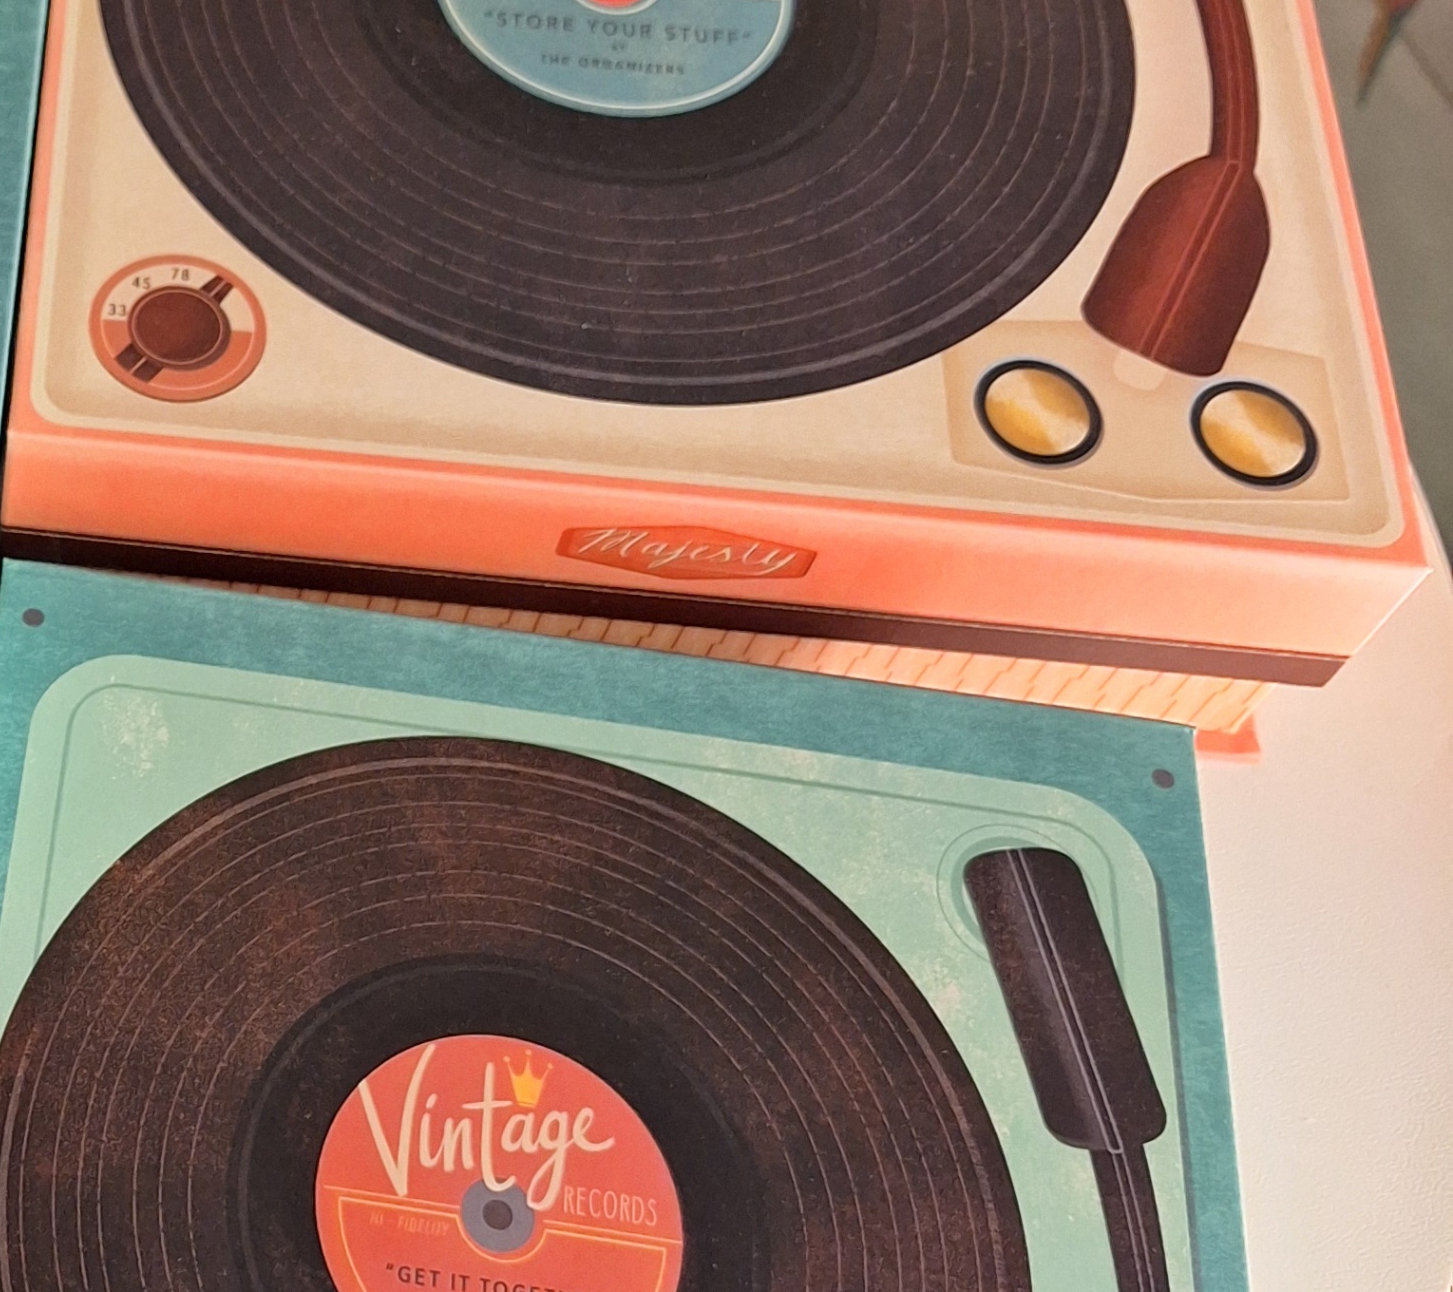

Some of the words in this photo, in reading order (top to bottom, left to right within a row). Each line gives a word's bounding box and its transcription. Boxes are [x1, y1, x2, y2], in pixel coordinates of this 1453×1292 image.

[587, 19, 653, 40] YOUR
[541, 54, 571, 67] THE
[578, 58, 685, 76] ORGANIZERS
[132, 276, 152, 290] 45
[171, 267, 190, 281] 78
[107, 303, 127, 317] 33
[578, 527, 797, 576] Majesty
[358, 1043, 615, 1211] Vintage
[563, 1185, 658, 1226] RECORDS
[451, 1273, 471, 1292] IT
